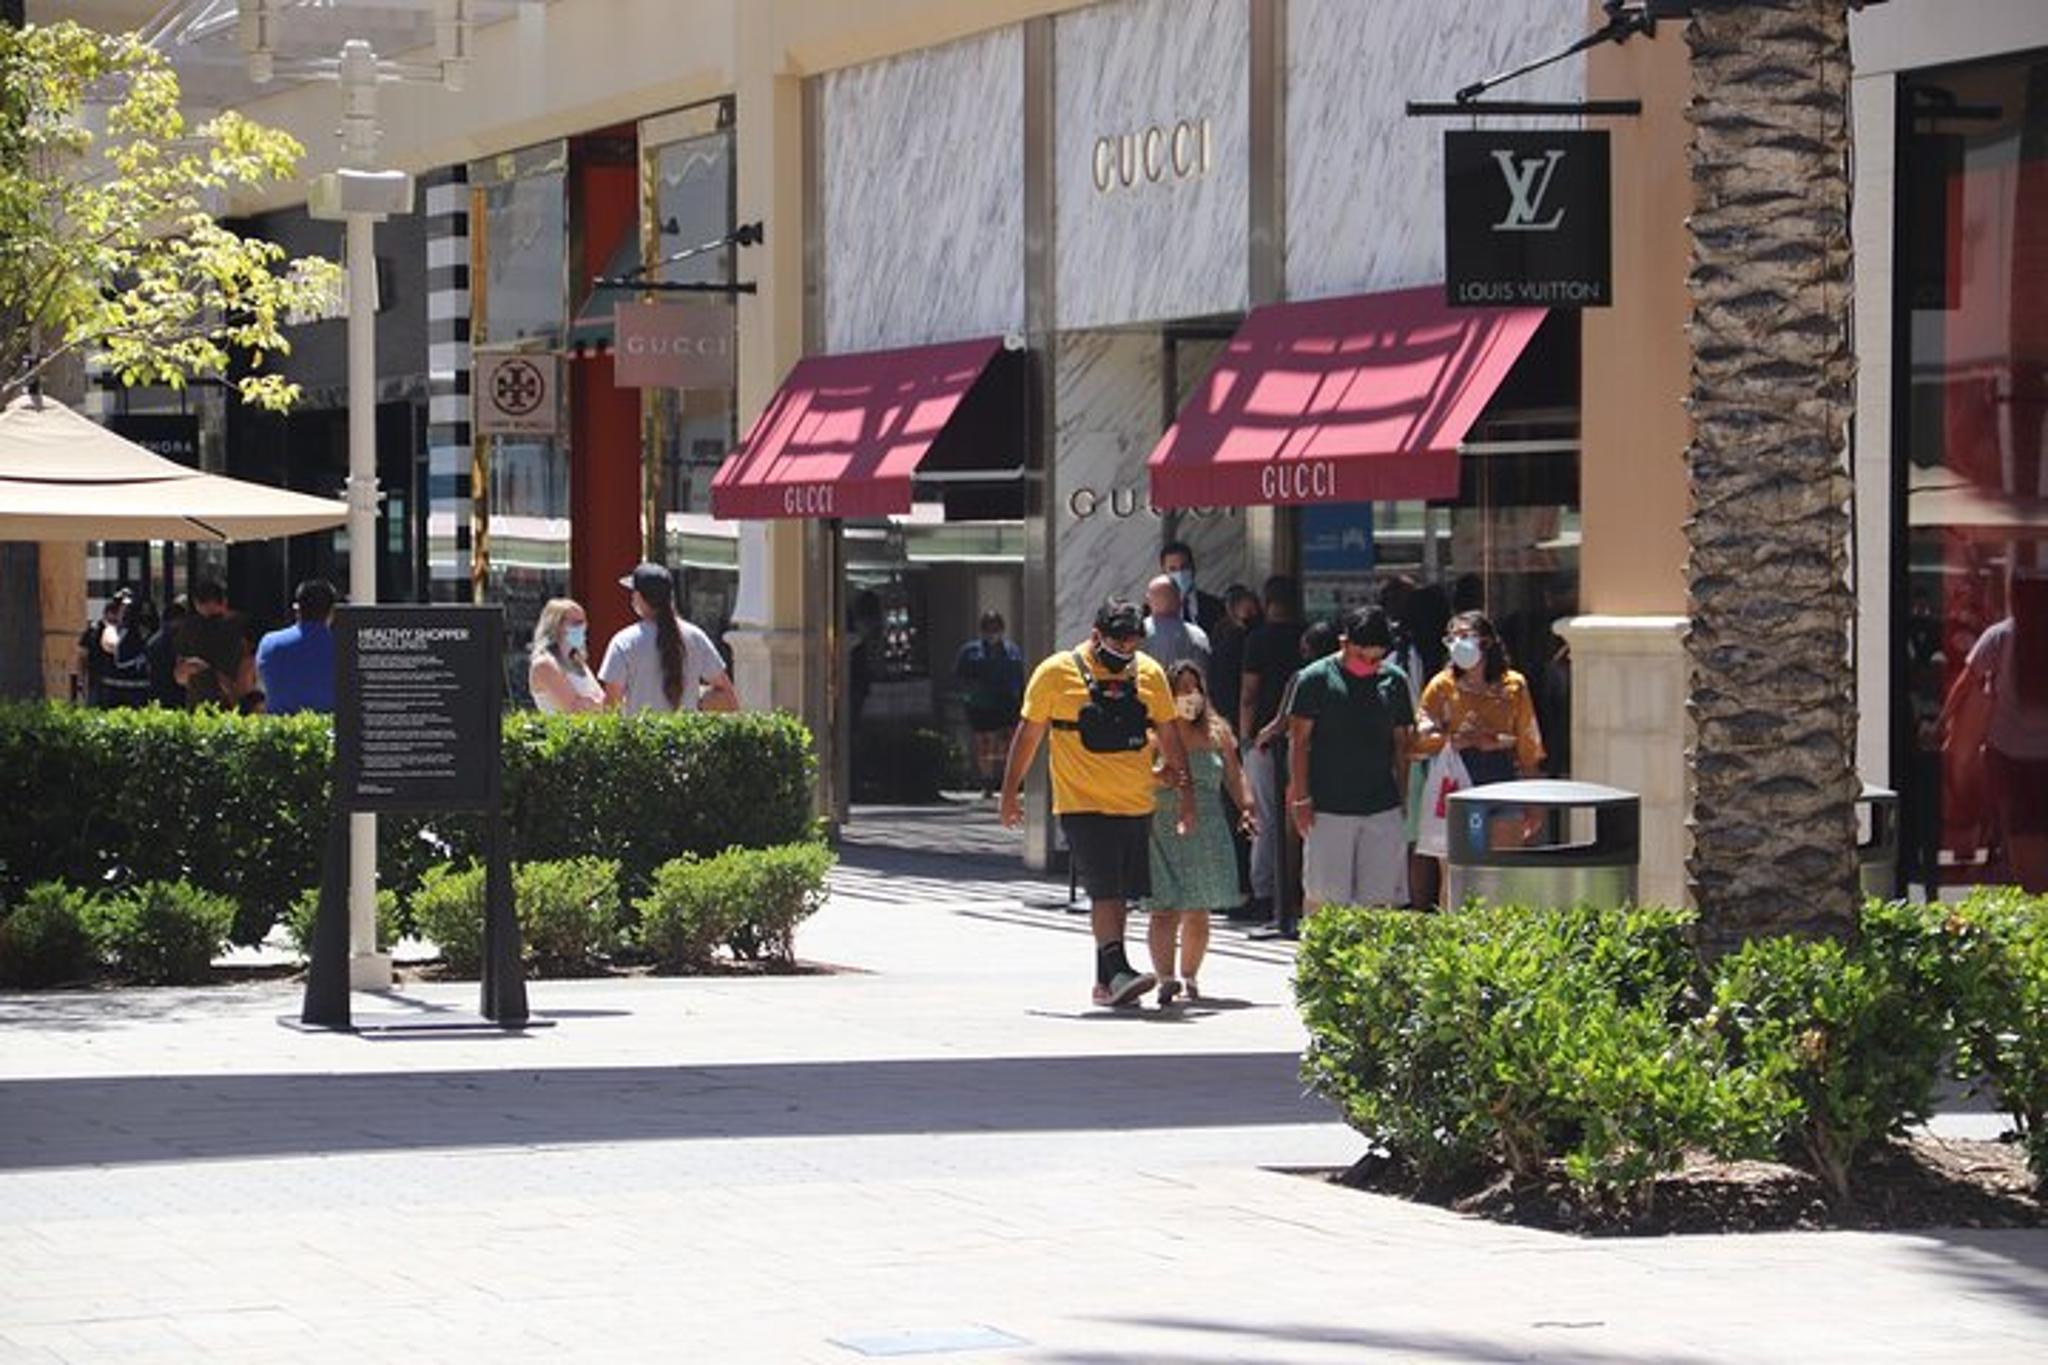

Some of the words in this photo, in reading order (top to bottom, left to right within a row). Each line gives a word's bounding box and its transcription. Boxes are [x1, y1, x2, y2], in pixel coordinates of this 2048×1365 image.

[1093, 119, 1210, 192] GUCCI
[1459, 282, 1514, 300] LOUIS
[1518, 282, 1600, 300] VUITTON
[627, 338, 726, 356] GUCCI
[1261, 462, 1335, 499] GUCCI
[784, 485, 834, 515] GUCCI
[358, 628, 412, 640] HEALTHY
[414, 628, 470, 640] SHOPPER
